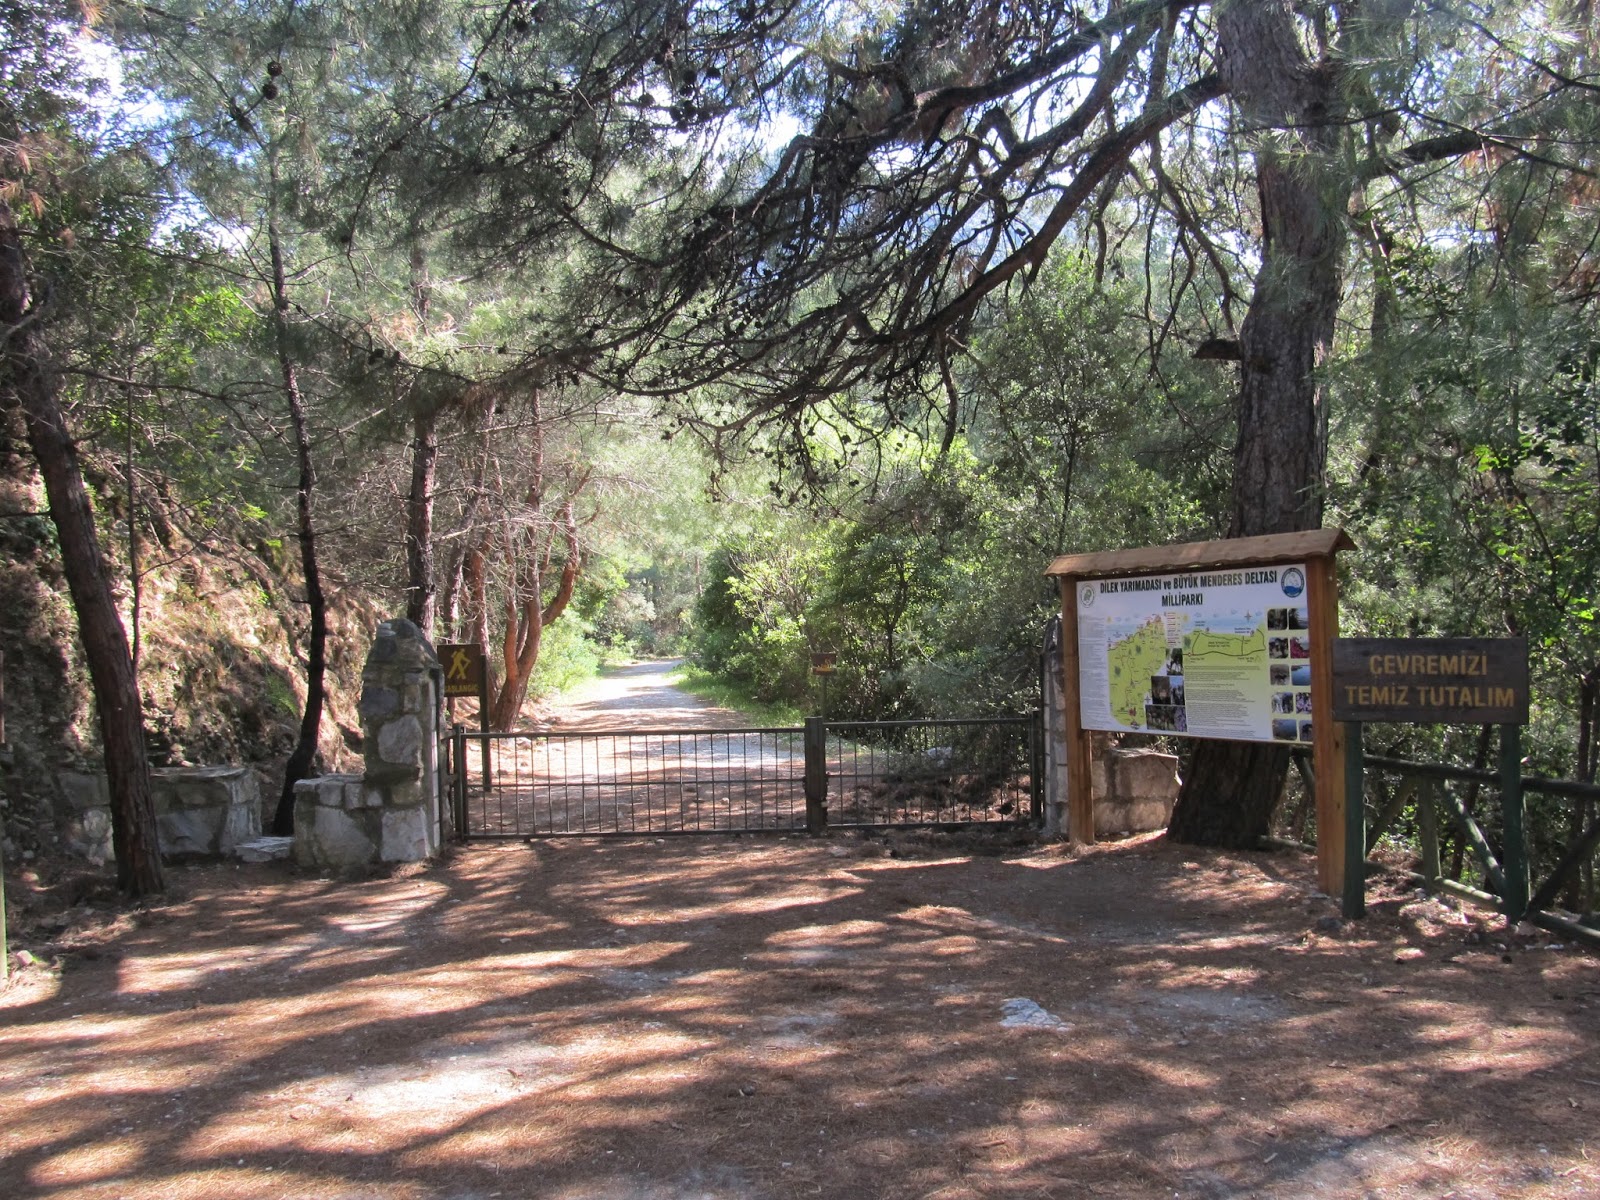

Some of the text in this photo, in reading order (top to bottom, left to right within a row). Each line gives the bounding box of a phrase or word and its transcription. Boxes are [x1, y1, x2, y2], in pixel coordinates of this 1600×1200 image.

[1100, 580, 1118, 593] DİLEK
[1120, 579, 1161, 592] YARIMADASI
[1163, 580, 1171, 590] ve
[1173, 574, 1198, 589] BÜYÜK
[1200, 573, 1242, 587] MENDERES
[1245, 570, 1277, 584] DELTASI
[1369, 651, 1488, 678] ÇEVREMİZİ
[1344, 683, 1515, 708] TEMİZ TUTALIM
